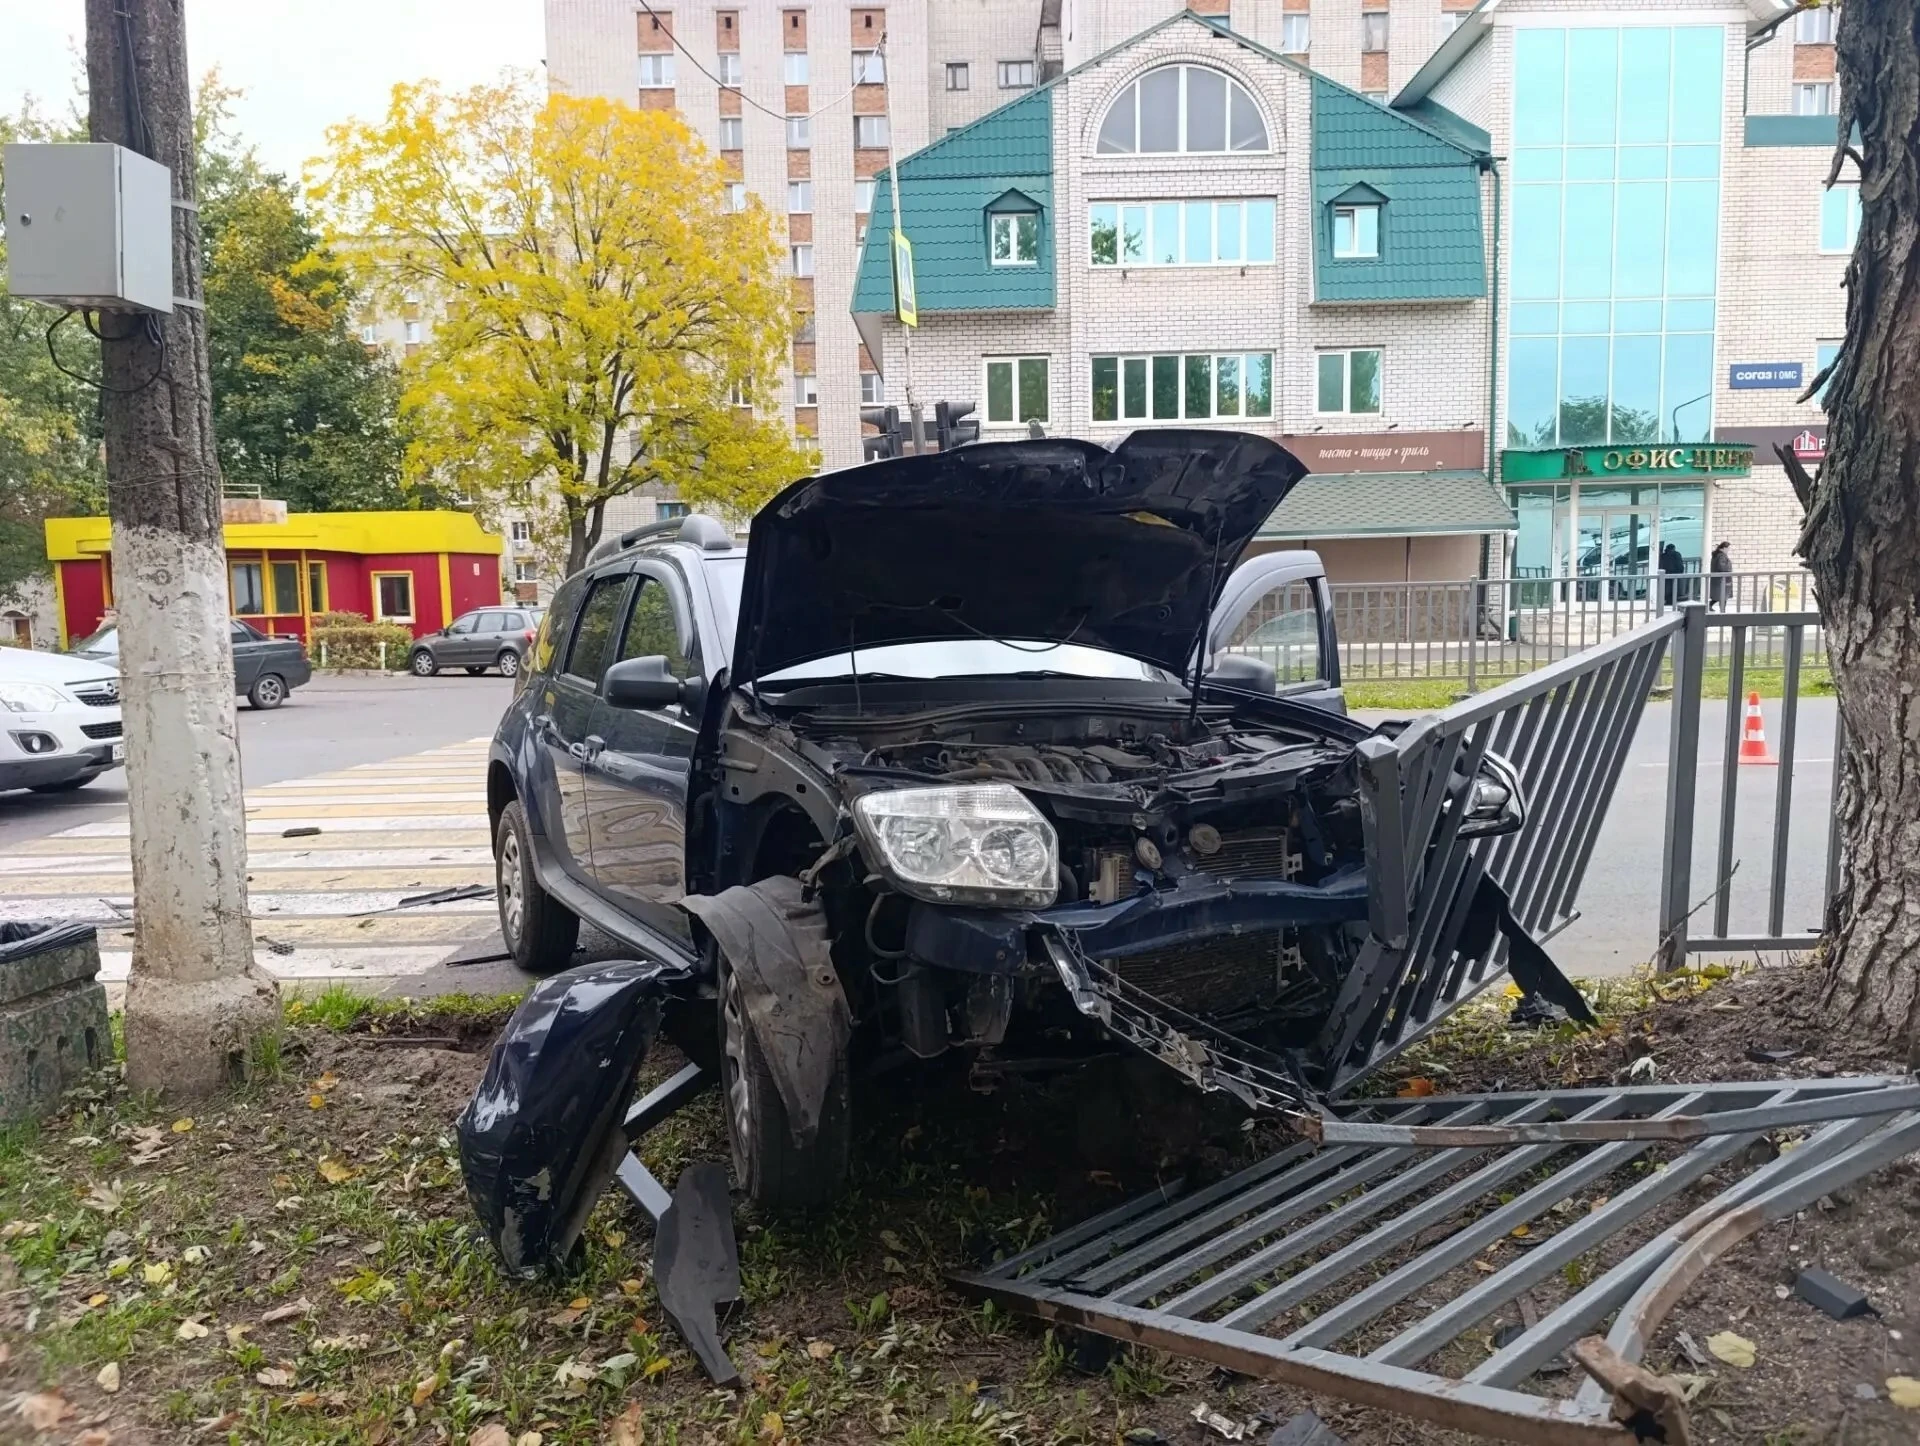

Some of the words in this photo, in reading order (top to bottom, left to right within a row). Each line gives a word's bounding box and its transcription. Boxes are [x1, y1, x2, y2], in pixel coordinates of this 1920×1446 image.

[1778, 370, 1798, 380] ОМС
[1319, 449, 1352, 459] паста
[1360, 448, 1392, 461] пицца
[1400, 447, 1429, 465] гриль
